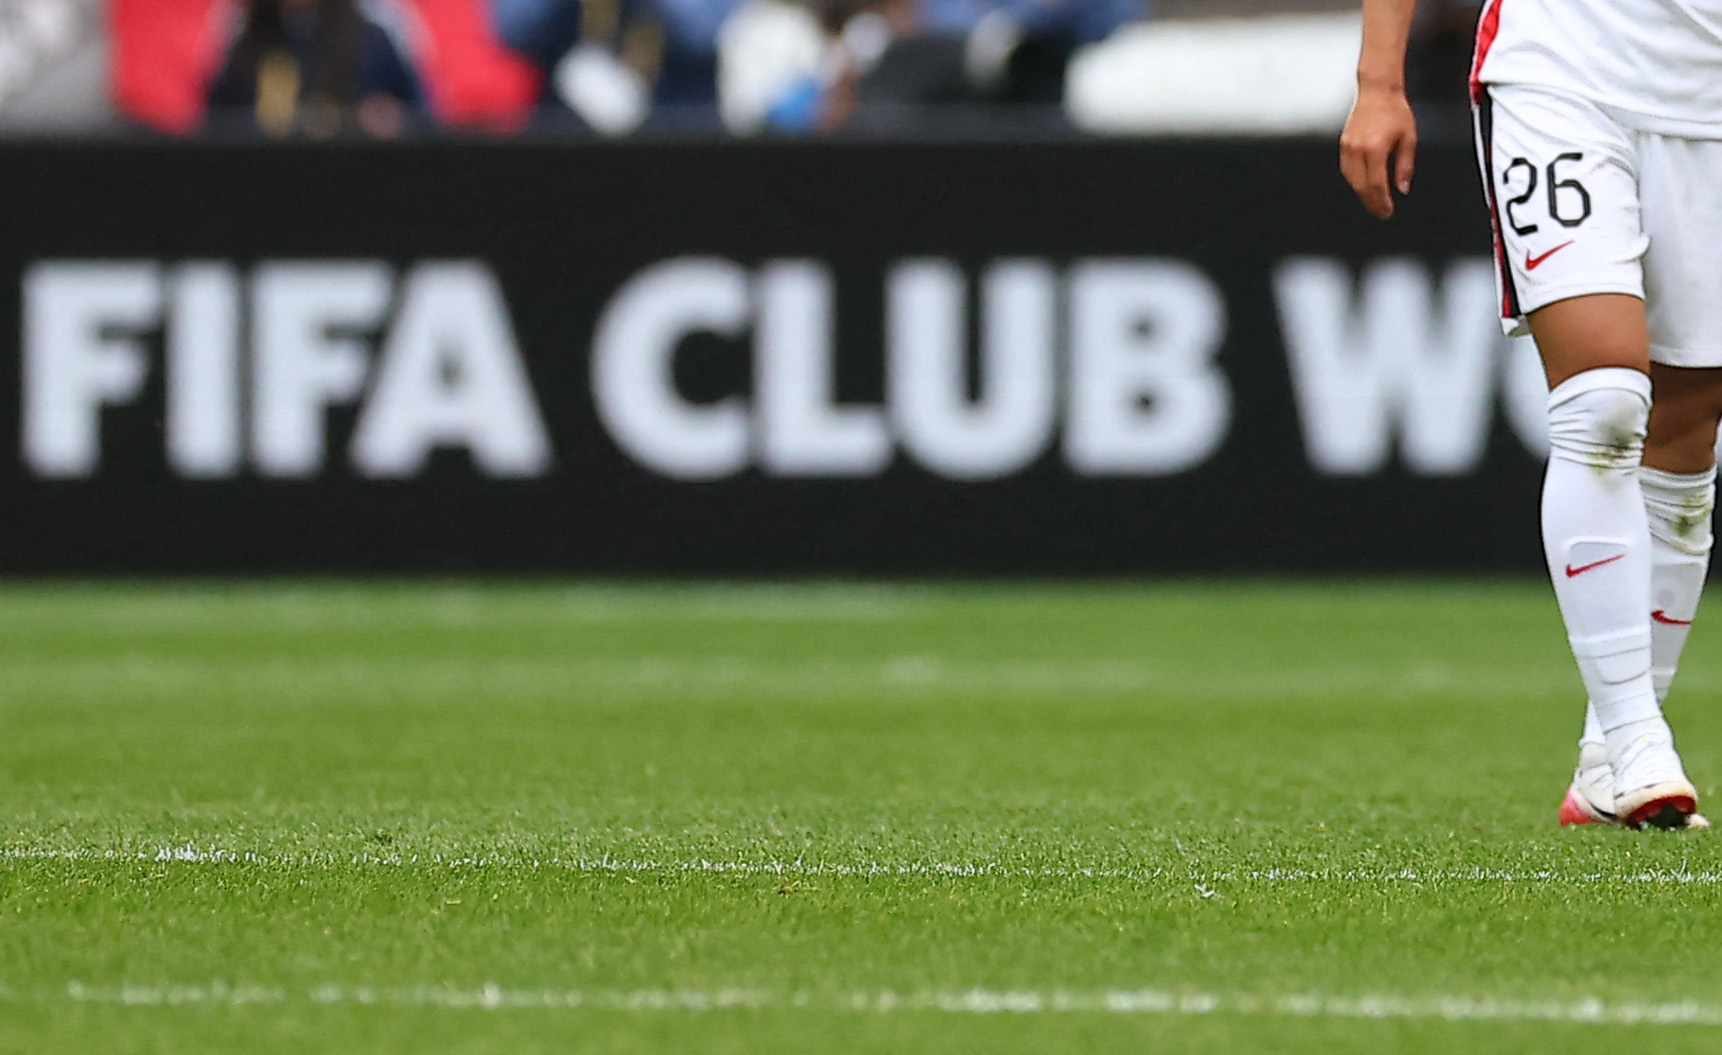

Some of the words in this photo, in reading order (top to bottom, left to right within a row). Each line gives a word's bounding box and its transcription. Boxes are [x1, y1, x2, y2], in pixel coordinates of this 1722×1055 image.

[1503, 152, 1591, 236] 26
[23, 261, 548, 475] FIFA
[591, 257, 1229, 477] CLUB
